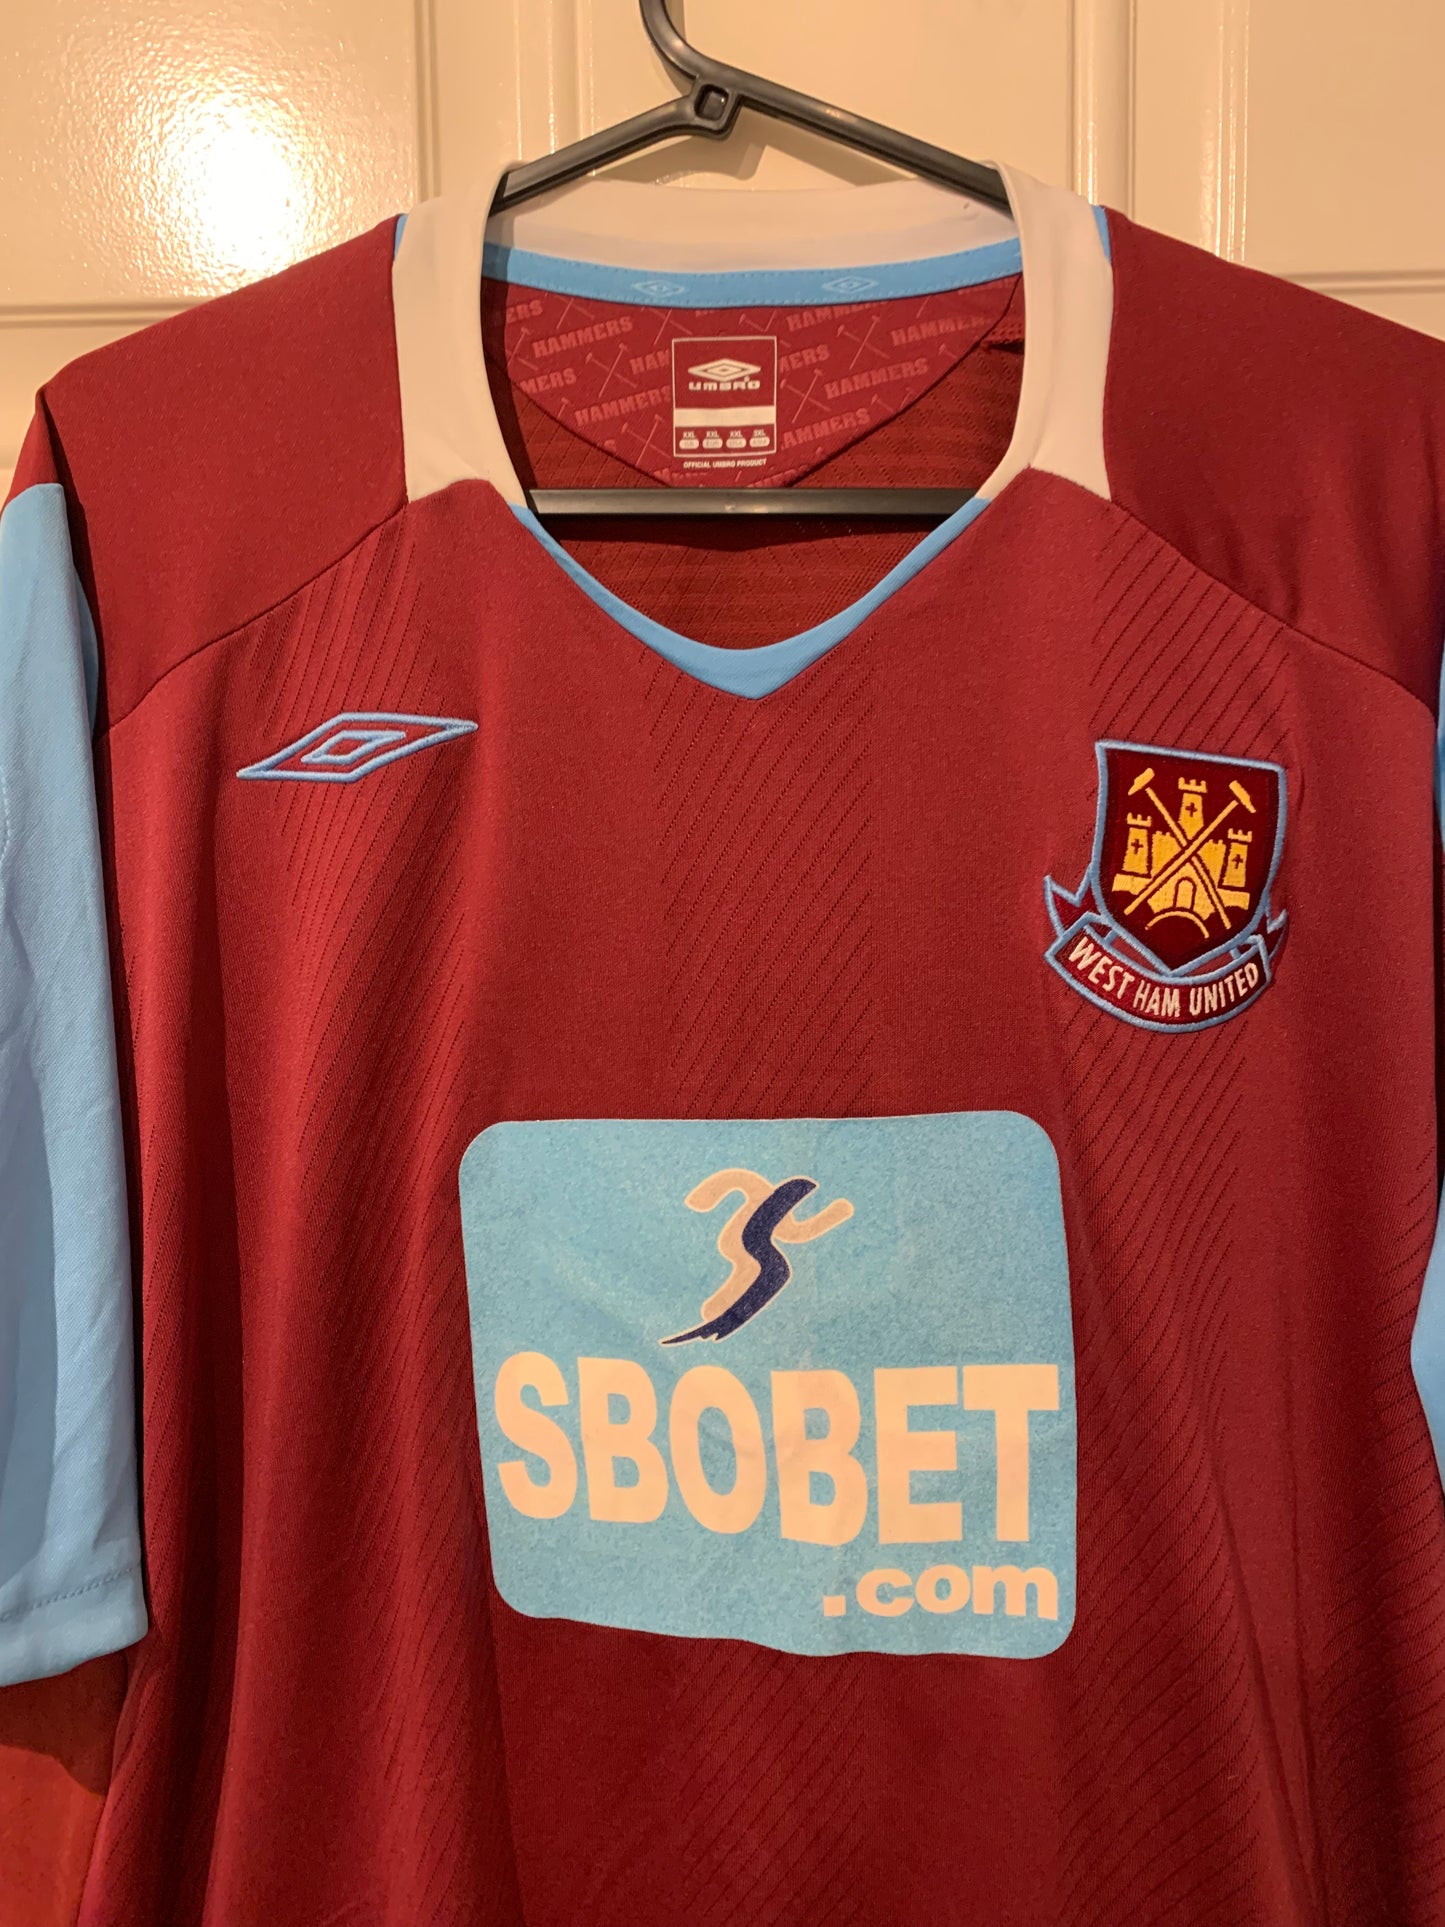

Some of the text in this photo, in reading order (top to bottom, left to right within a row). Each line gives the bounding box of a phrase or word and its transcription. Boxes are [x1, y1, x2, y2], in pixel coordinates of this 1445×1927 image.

[532, 316, 633, 358] HAMMERS
[688, 380, 761, 391] UMBRO
[824, 358, 929, 399] HAMMERS
[781, 407, 871, 450] AMMERS
[683, 458, 767, 469] OFFICIAL UMBRO PRODUCT
[1068, 936, 1259, 1017] WEST HAM UNITED
[494, 1351, 1060, 1546] SBOBET
[823, 1563, 1059, 1621] .com
